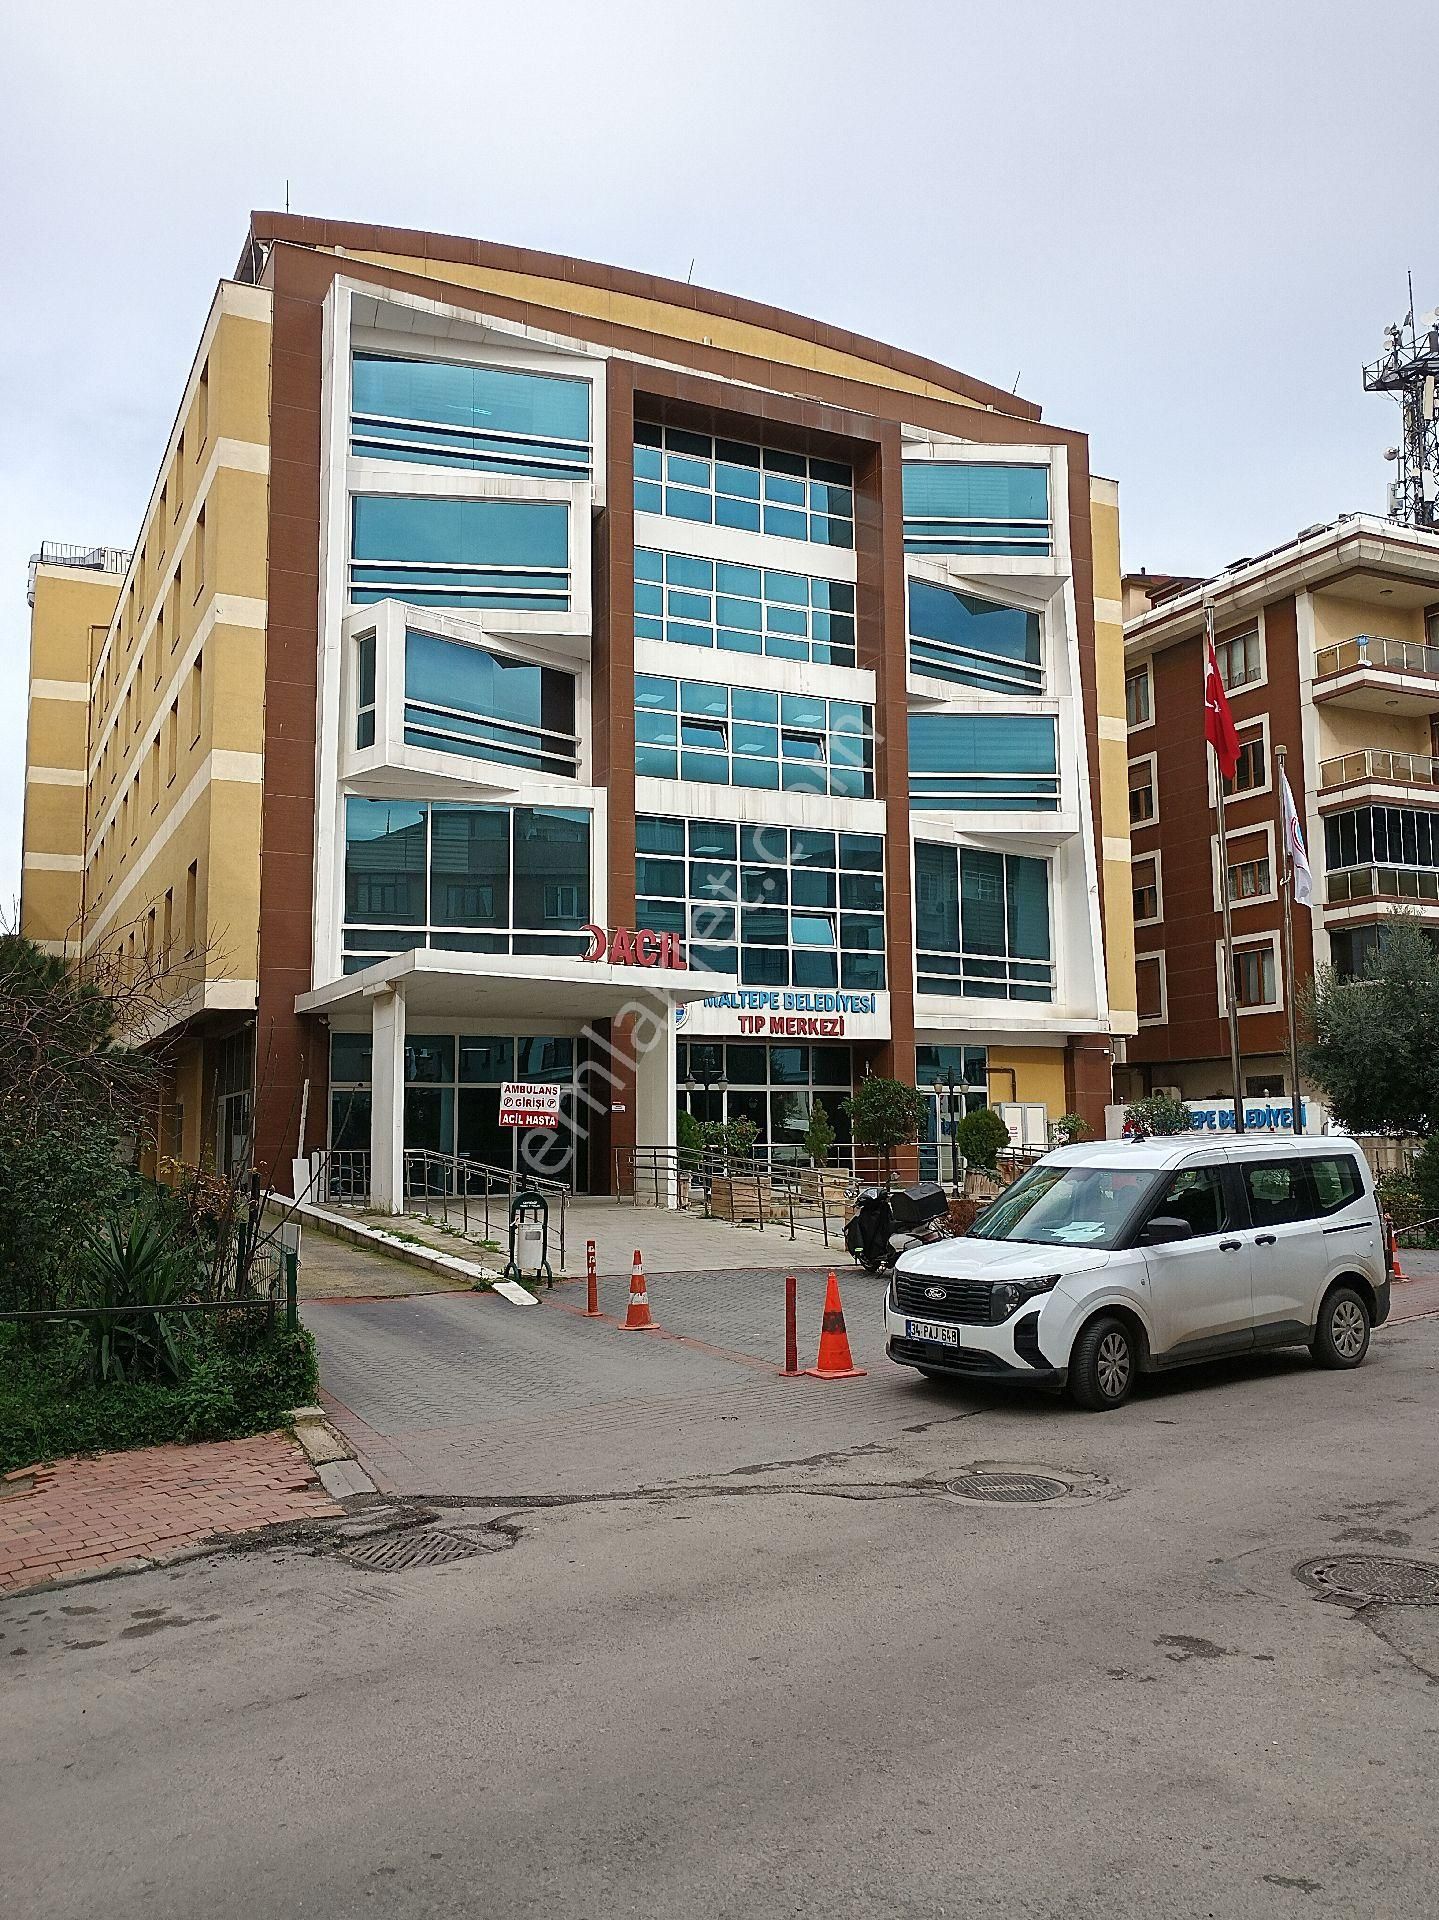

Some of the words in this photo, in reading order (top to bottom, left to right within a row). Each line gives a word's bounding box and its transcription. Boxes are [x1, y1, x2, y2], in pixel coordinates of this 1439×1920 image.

[783, 991, 876, 1014] BELEDİYESİ
[738, 1016, 766, 1034] TIP
[769, 1015, 845, 1037] MERKEZİ
[504, 1085, 558, 1095] AMBULANS
[515, 1096, 545, 1109] GİRİŞİ
[502, 1113, 523, 1124] ACİL
[526, 1115, 555, 1125] HASTA
[1218, 1103, 1306, 1130] BEEDİYEİ
[911, 1323, 920, 1336] 34
